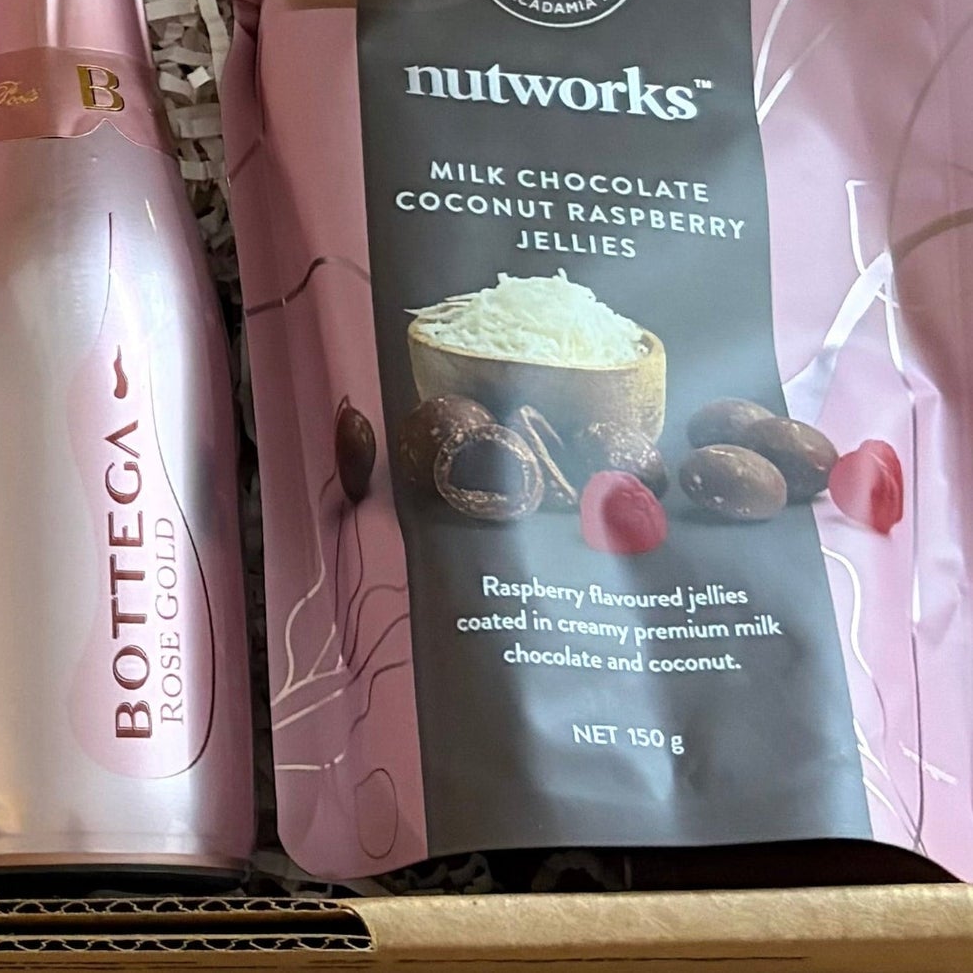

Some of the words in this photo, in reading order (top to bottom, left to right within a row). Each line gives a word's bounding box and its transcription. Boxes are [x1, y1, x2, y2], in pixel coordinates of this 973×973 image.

[77, 64, 125, 112] B
[429, 160, 506, 185] MILK
[517, 169, 710, 203] CHOCOLATE
[395, 191, 555, 220] COCONUT
[567, 202, 746, 240] RASPBERRY
[516, 229, 637, 259] JELLIES
[105, 419, 153, 738] BOTTEGA
[155, 517, 179, 621] GOLD
[482, 576, 584, 609] Raspberry
[588, 583, 683, 608] flavoured
[686, 584, 749, 614] jellies
[456, 610, 526, 632] coated
[532, 610, 553, 632] in
[557, 617, 628, 645] creamy
[634, 622, 729, 646] premium
[735, 615, 783, 637] milk
[160, 631, 184, 725] ROSE
[503, 643, 603, 670] chocolate
[607, 651, 643, 672] and
[648, 653, 742, 673] coconut.
[572, 724, 617, 745] NET
[627, 727, 665, 748] 150
[670, 733, 684, 755] g
